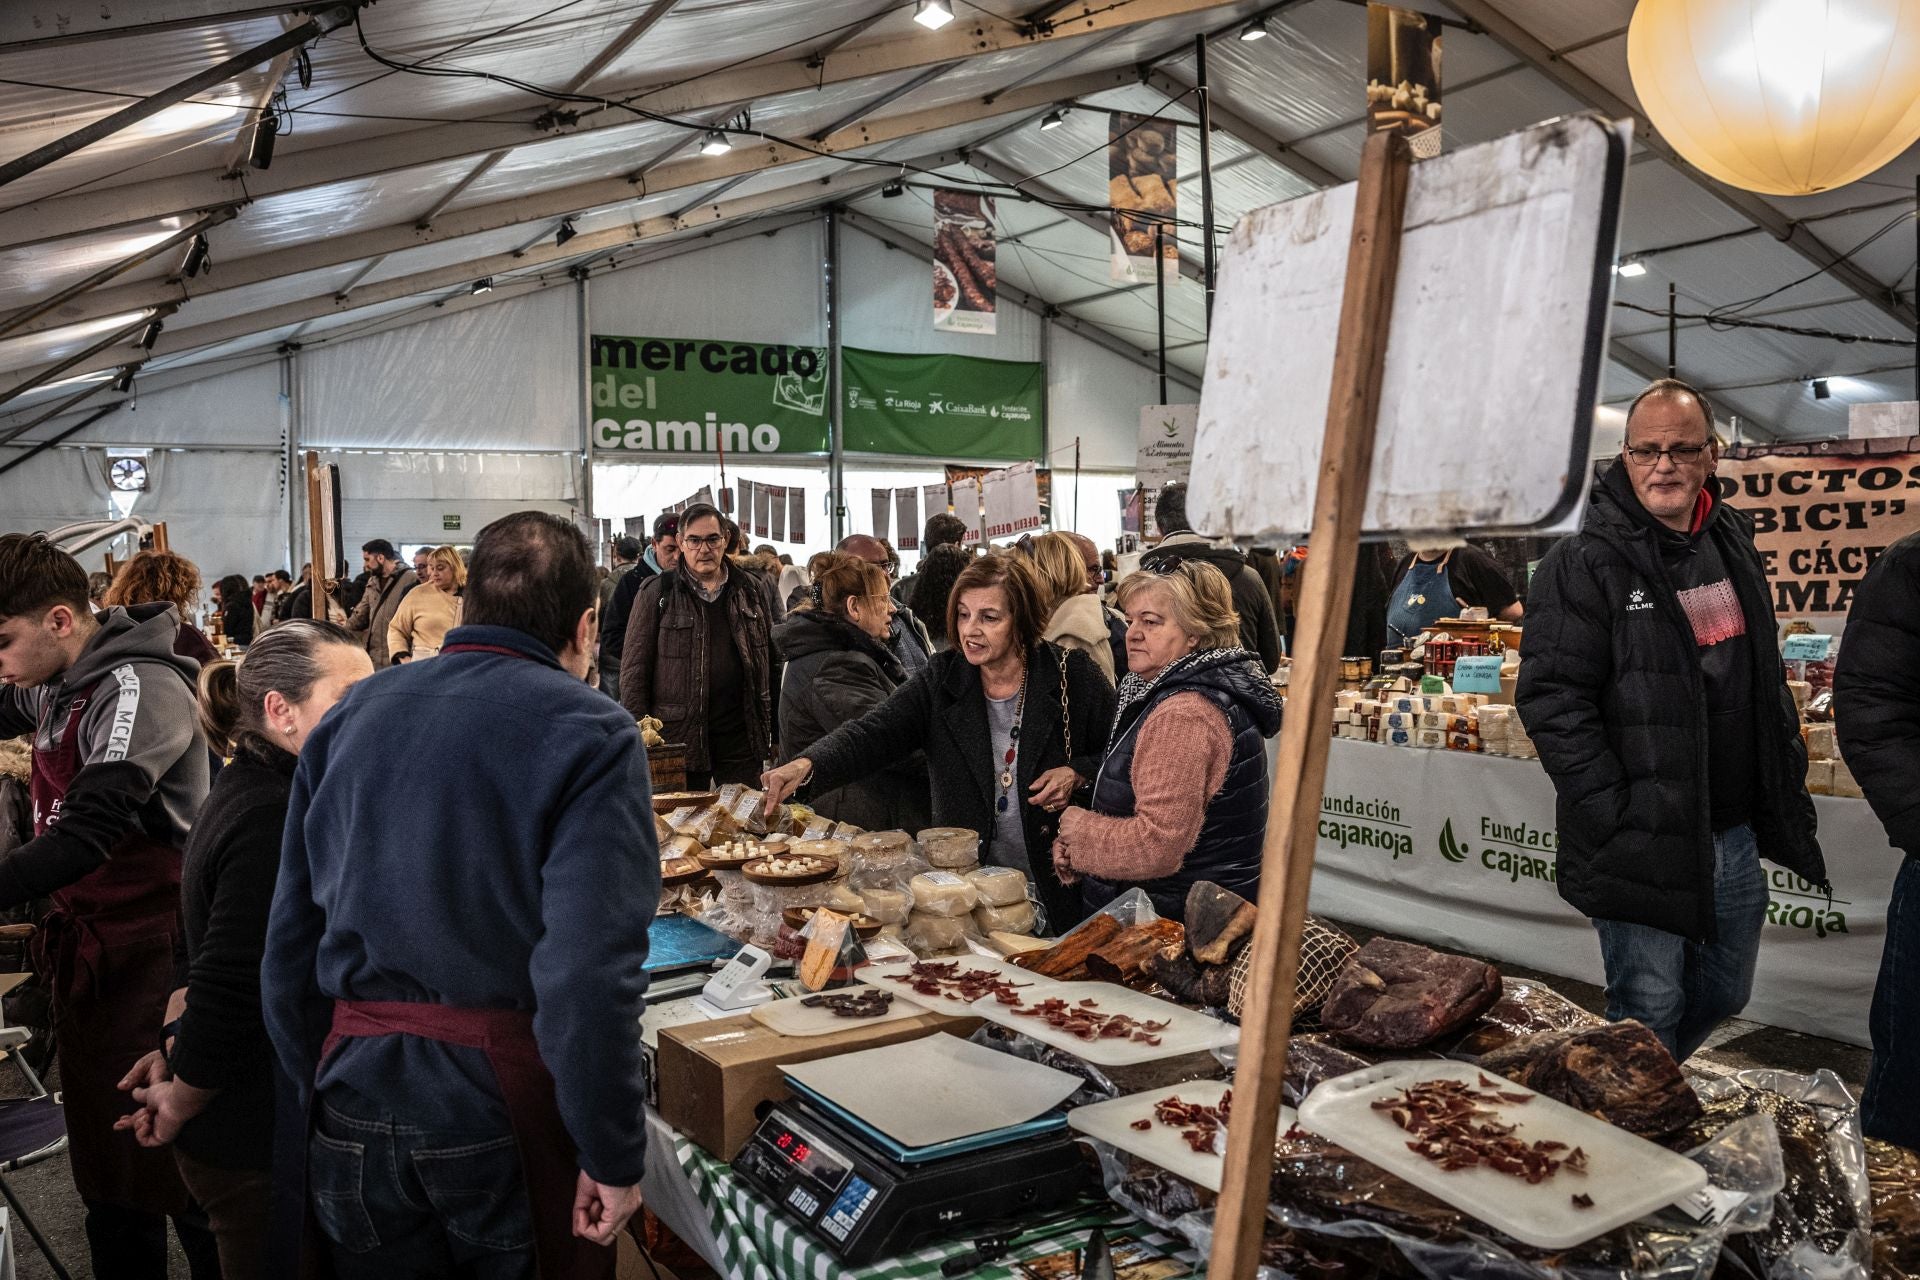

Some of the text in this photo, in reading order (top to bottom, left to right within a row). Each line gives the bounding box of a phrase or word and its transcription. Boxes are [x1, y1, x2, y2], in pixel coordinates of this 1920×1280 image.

[591, 337, 818, 377] mercado
[592, 375, 656, 409] del
[895, 400, 921, 409] La Rioja
[946, 402, 987, 414] CaixaBank
[592, 412, 781, 452] camino
[1768, 579, 1862, 612] MA
[1320, 793, 1400, 822] undación
